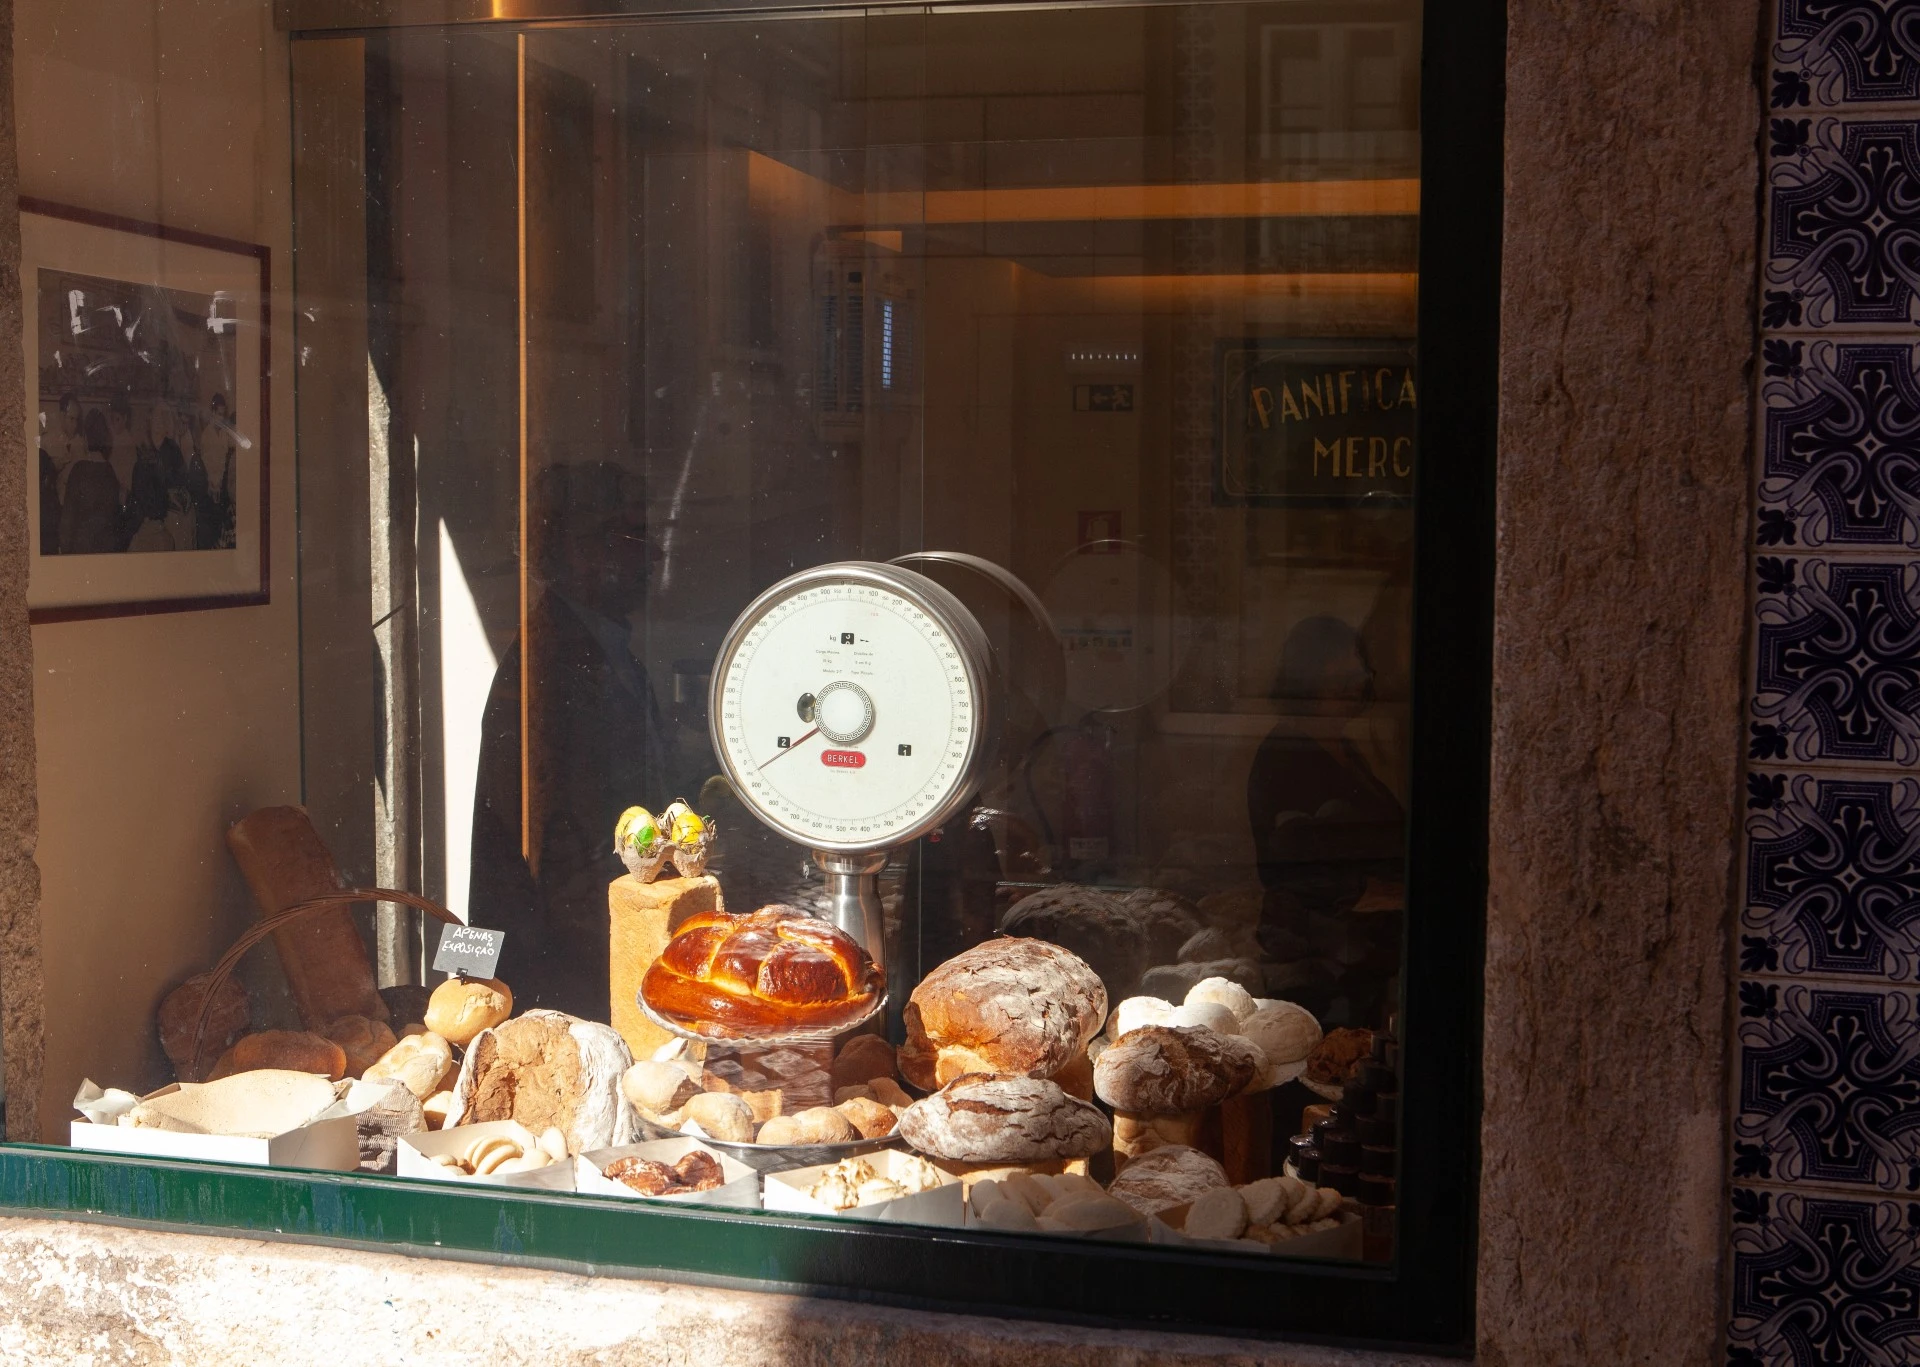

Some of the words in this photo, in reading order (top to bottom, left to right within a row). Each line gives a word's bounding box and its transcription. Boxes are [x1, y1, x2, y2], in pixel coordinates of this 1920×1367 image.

[1250, 368, 1416, 429] PANIFICA
[1313, 436, 1411, 478] MERC
[828, 754, 858, 764] BERKEL
[453, 926, 494, 942] APENAS
